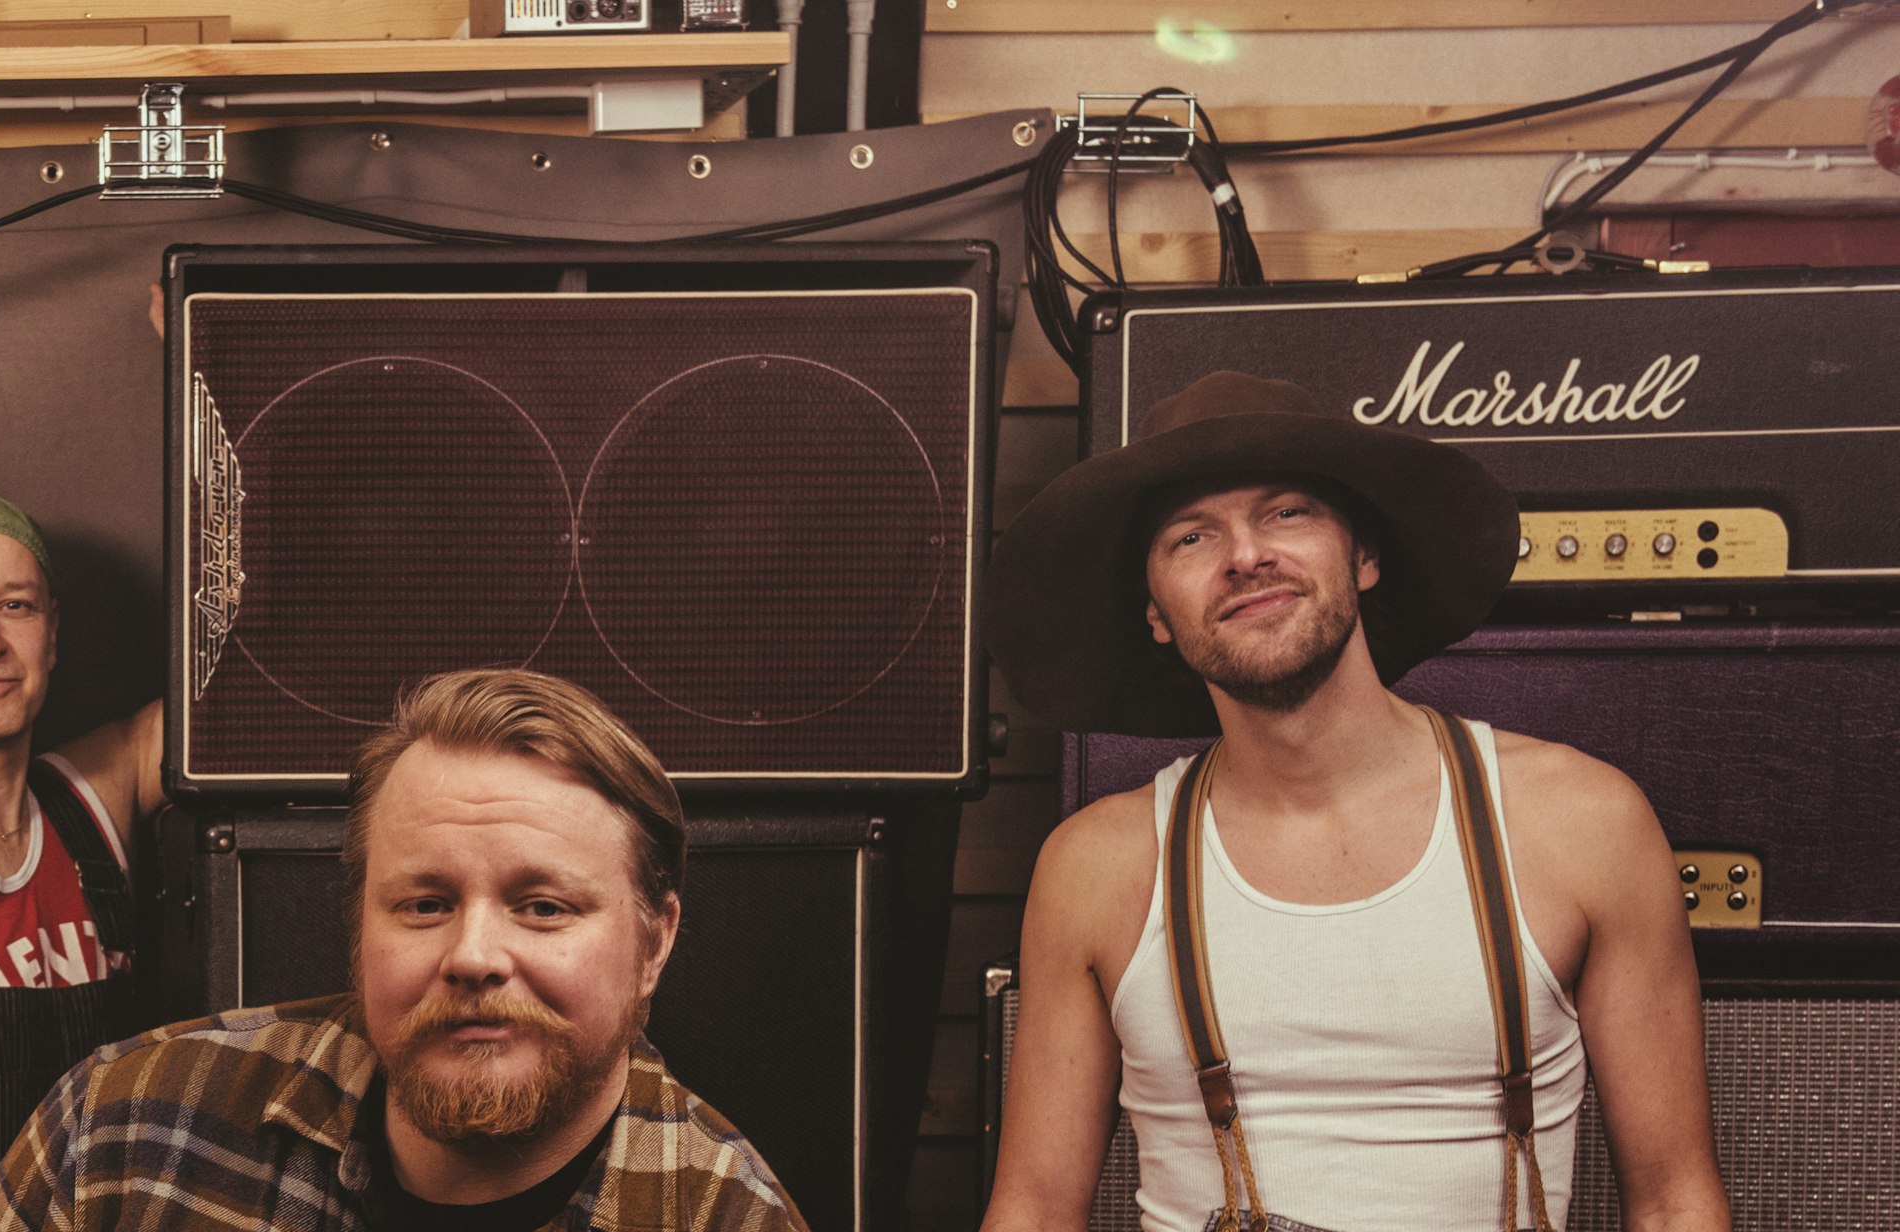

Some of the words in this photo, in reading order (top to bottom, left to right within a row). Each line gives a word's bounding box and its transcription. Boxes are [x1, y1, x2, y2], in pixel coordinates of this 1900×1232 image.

[1352, 340, 1700, 426] Marshall
[197, 456, 225, 638] Ashdown
[1700, 883, 1735, 891] INPUTS
